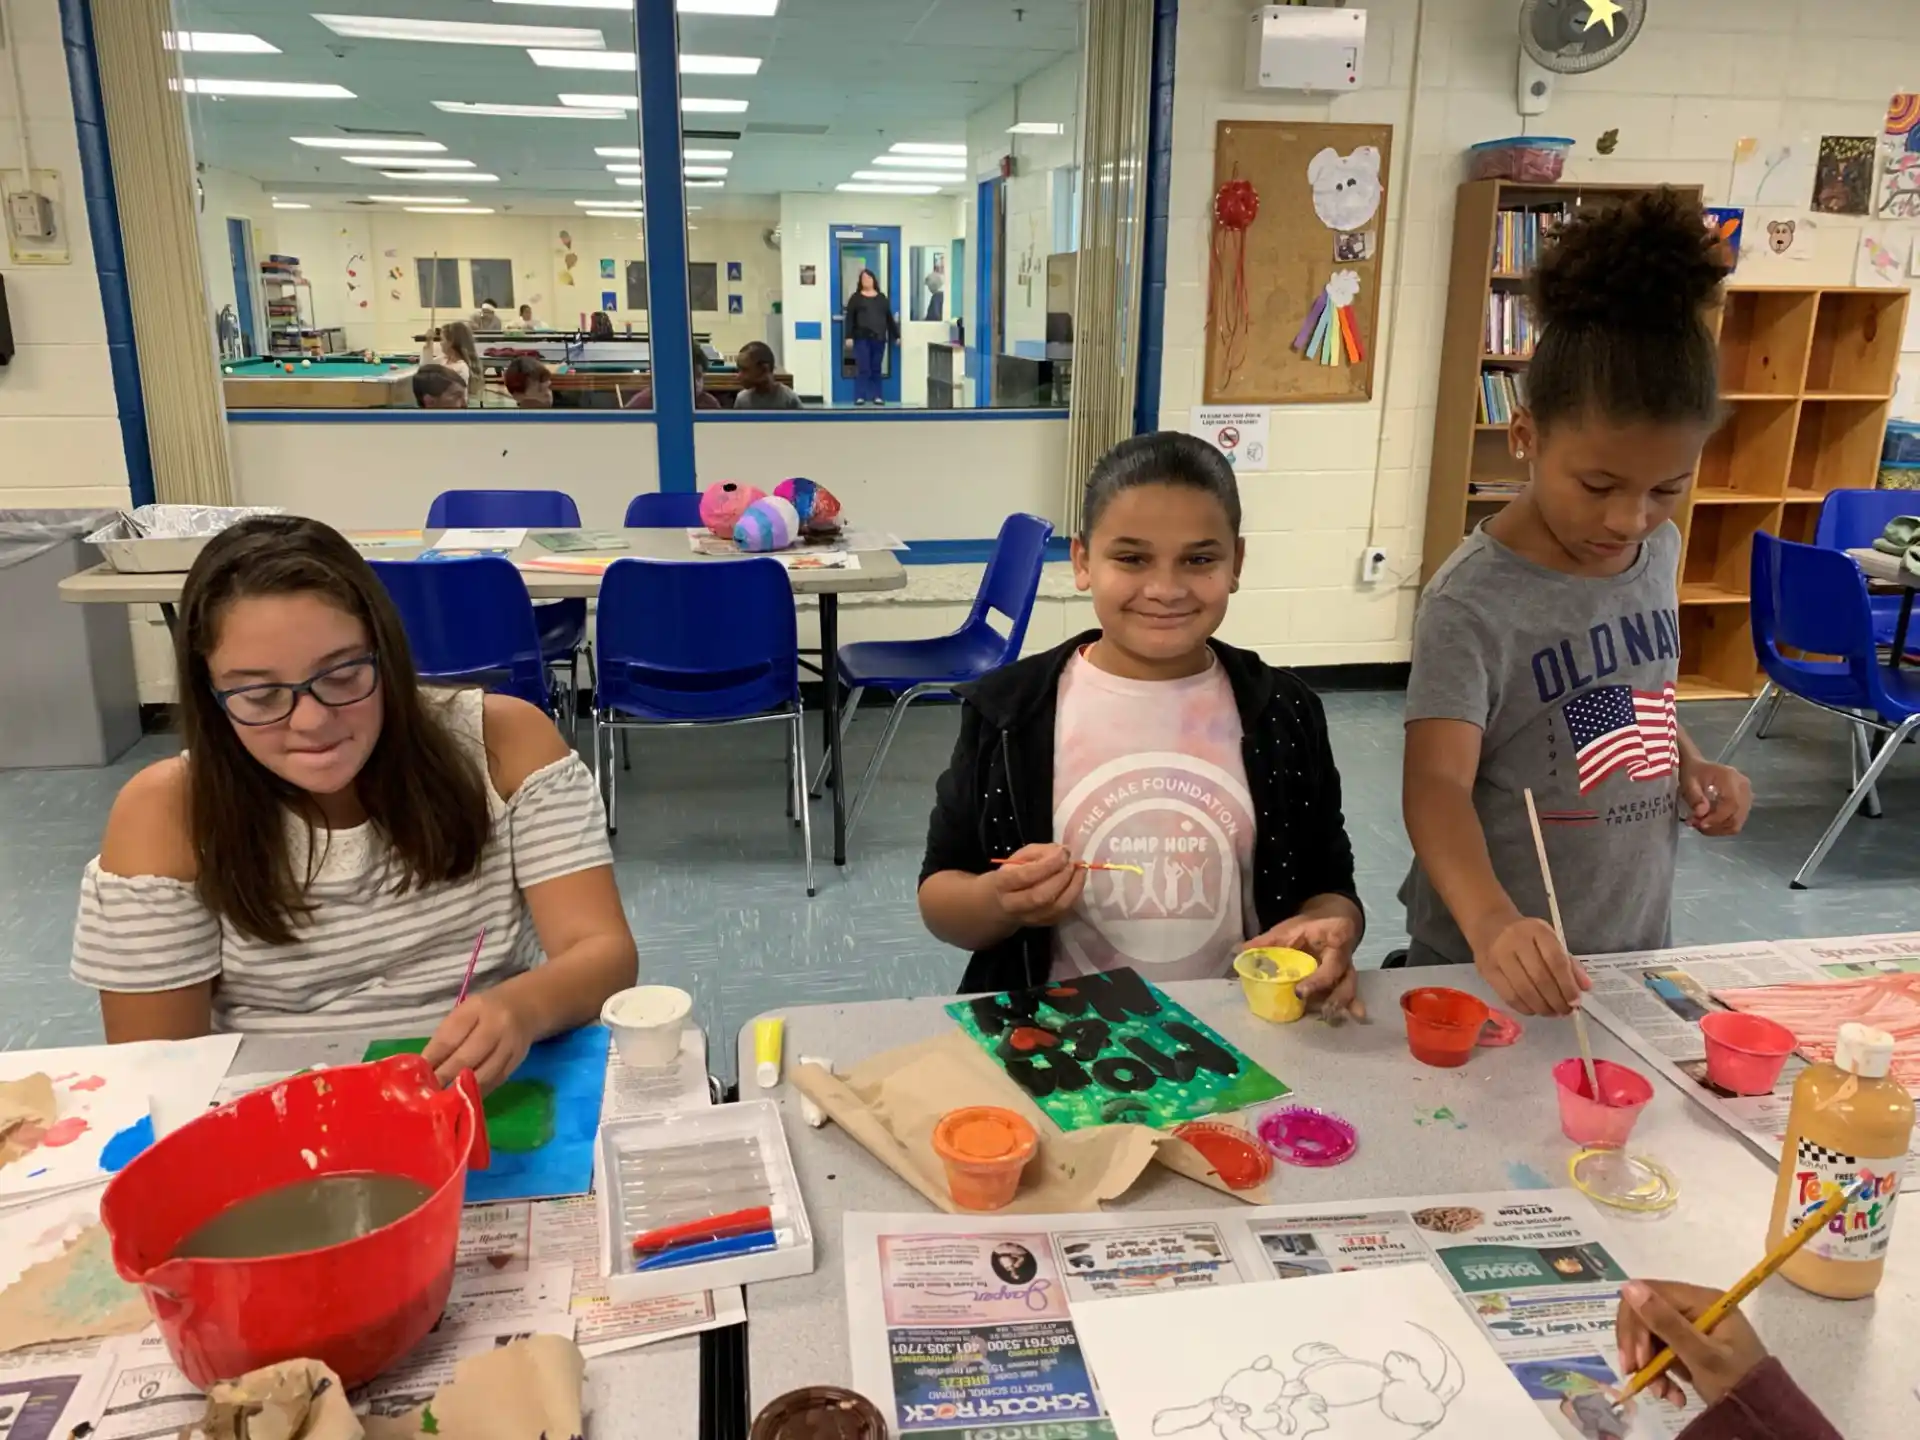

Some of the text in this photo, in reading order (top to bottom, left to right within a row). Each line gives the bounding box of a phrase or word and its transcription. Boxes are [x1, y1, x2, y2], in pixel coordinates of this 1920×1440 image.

[1531, 609, 1680, 703] OLD NAV
[1078, 777, 1240, 837] THE MAE FOUNDATION
[1109, 836, 1208, 854] CAMP HOPE
[1810, 1202, 1884, 1237] aint
[1473, 1230, 1581, 1243] EARLY BUY SPECIAL
[1338, 1246, 1376, 1254] Month
[1173, 1273, 1213, 1285] Annual
[1460, 1262, 1542, 1281] DOUGLAS
[891, 1342, 980, 1355] 401.305.7701
[988, 1335, 1076, 1352] 508.761.5300
[938, 1374, 990, 1388] BREEZE
[928, 1383, 1054, 1399] BACK TO SCHOOL PROMO
[993, 1392, 1090, 1416] SCHOOL
